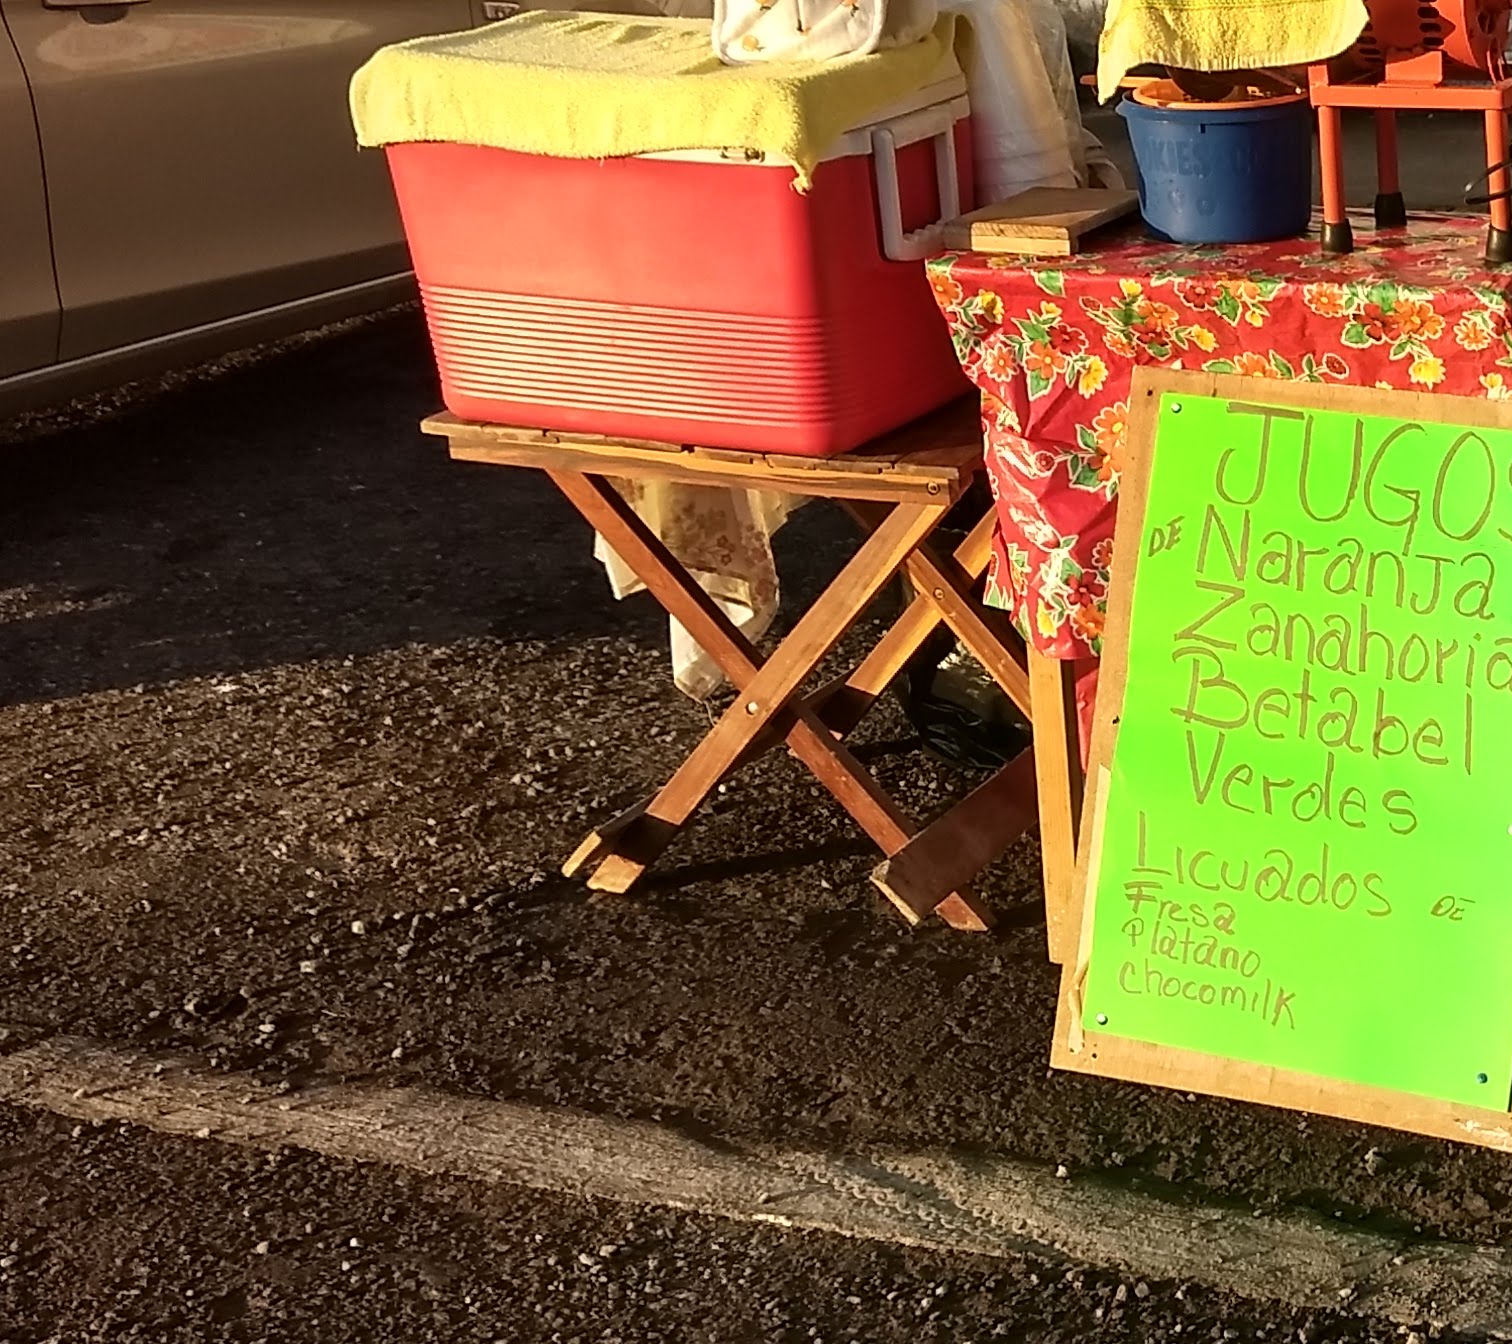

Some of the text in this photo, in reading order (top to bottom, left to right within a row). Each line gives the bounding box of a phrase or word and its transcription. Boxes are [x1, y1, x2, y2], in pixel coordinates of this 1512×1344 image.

[1147, 515, 1186, 558] DE
[1170, 645, 1473, 776] Betabel
[1186, 729, 1418, 836] Verdes
[1132, 810, 1393, 917] Licuados
[1121, 917, 1262, 979] Platano
[1123, 881, 1237, 936] Fresa
